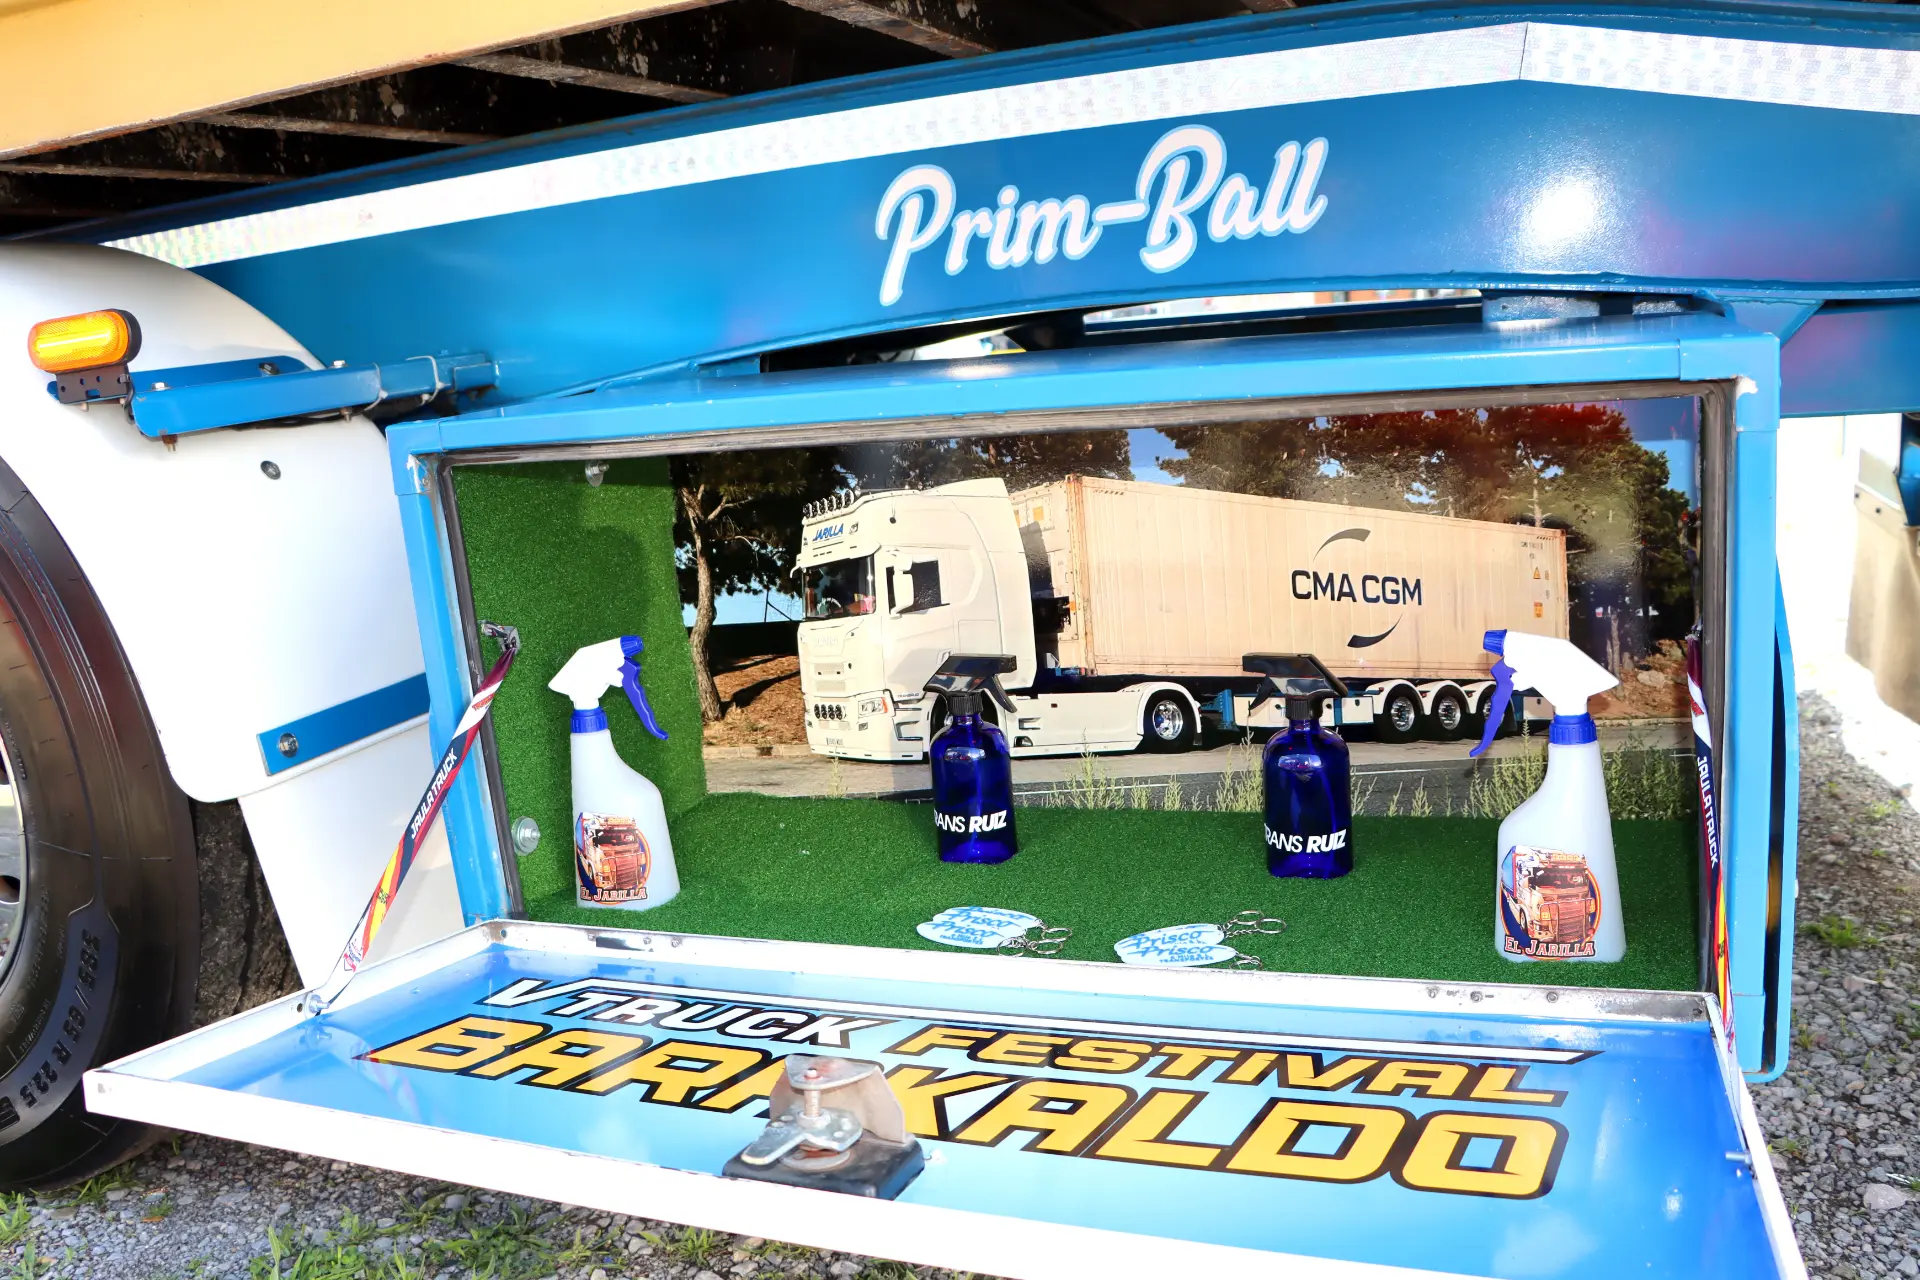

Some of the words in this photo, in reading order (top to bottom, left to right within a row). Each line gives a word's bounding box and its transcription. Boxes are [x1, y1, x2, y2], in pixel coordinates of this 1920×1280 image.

[875, 124, 1329, 306] Prim-Ball
[1291, 569, 1357, 603] CMA
[1361, 574, 1423, 606] CGM
[968, 809, 1008, 834] RUIZ
[1305, 829, 1347, 854] RUIZ
[593, 887, 648, 901] JARILLA
[1504, 935, 1522, 953] EL
[1525, 939, 1596, 957] JARILLA
[541, 990, 902, 1049] TRUCK
[881, 1022, 1569, 1108] FESTIVAL
